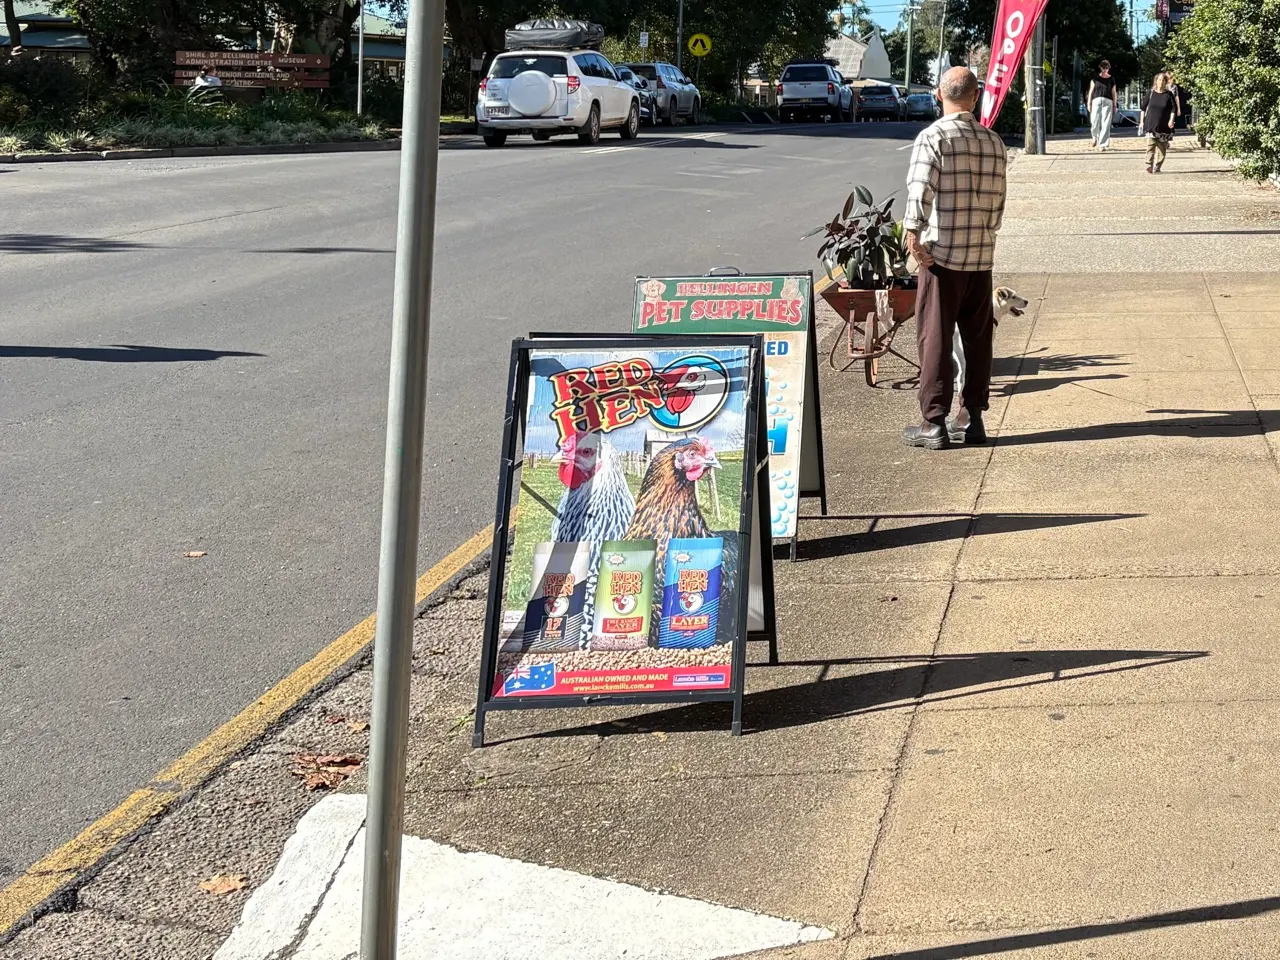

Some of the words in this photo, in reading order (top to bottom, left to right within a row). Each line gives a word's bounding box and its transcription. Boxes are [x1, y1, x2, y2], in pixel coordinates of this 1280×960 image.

[185, 58, 244, 66] ADMINISTRATION
[981, 10, 1024, 119] OPEN
[244, 71, 274, 79] CITIZENS
[677, 281, 773, 297] BELLINGEN
[639, 299, 687, 329] PET
[690, 298, 803, 326] SUPPLIES
[549, 358, 654, 406] RED
[553, 382, 665, 447] HEN
[545, 572, 575, 586] RED
[611, 570, 642, 583] RED
[679, 569, 709, 581] RED
[544, 584, 574, 597] HEN
[610, 581, 642, 595] HEN
[678, 580, 708, 593] HEN
[546, 617, 563, 630] 17
[671, 615, 708, 626] LAYER
[560, 676, 602, 685] AUSTRALIAN
[605, 675, 631, 683] OWNED
[632, 674, 648, 682] AND
[649, 673, 669, 682] MADE
